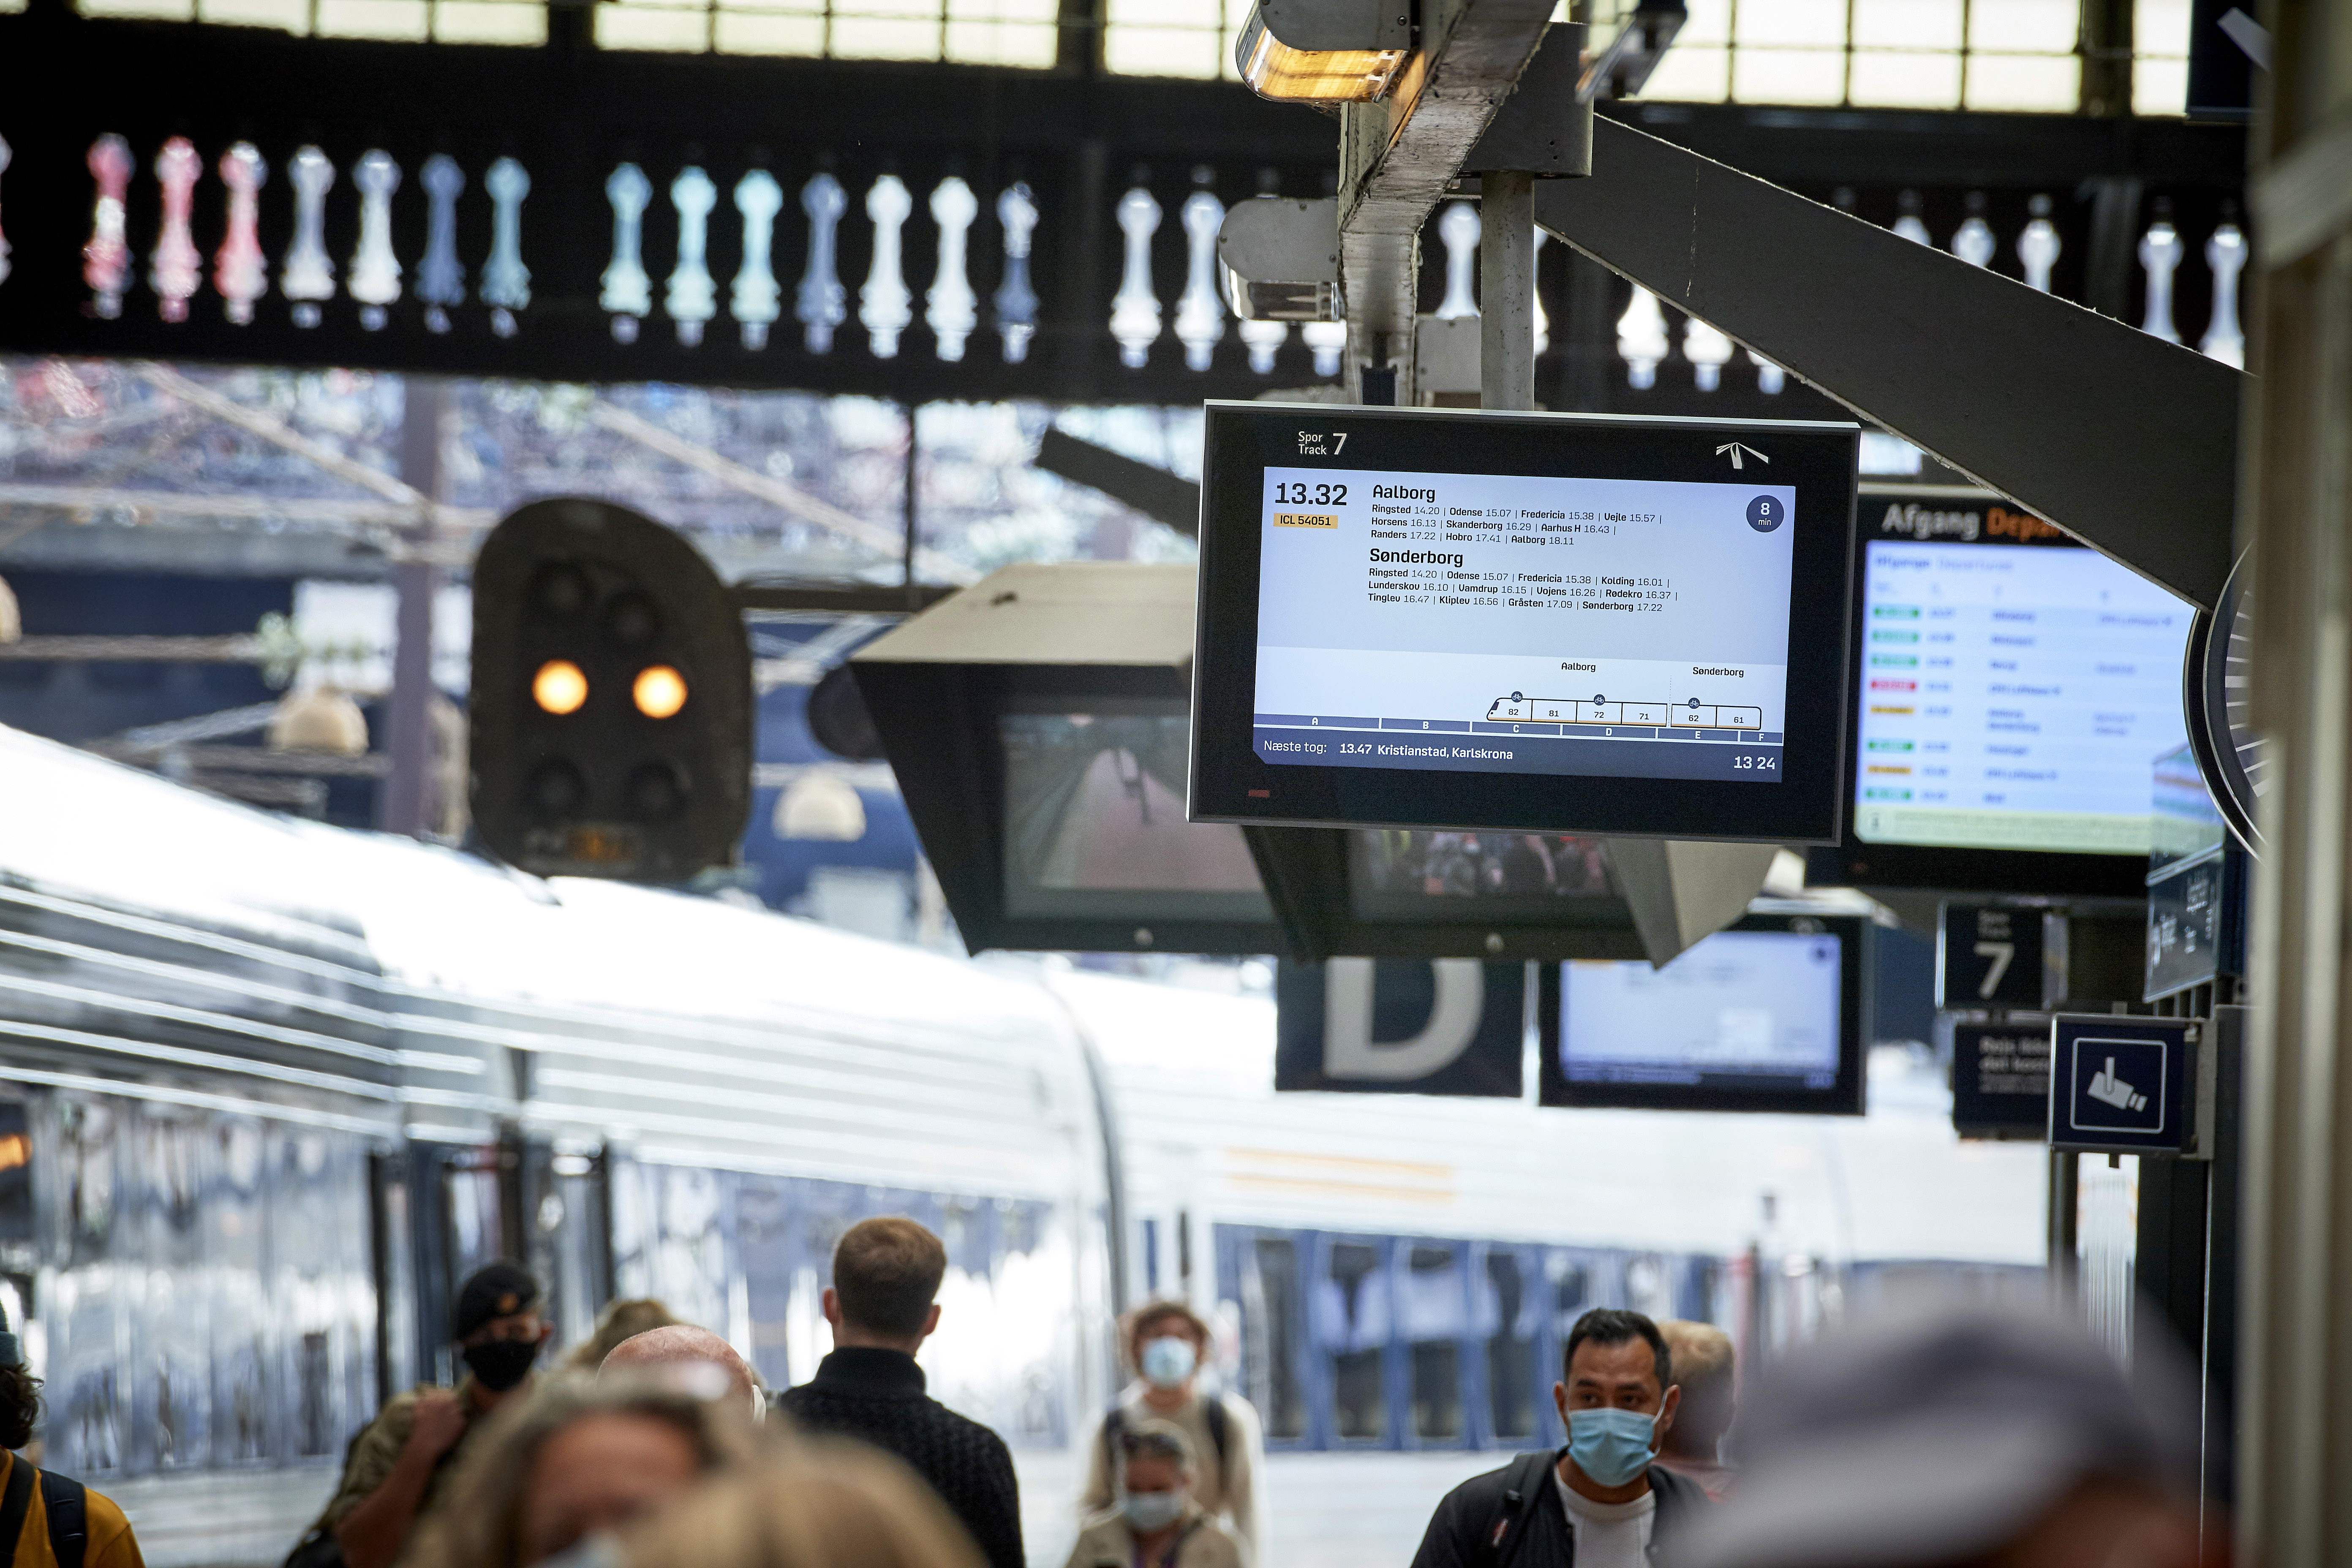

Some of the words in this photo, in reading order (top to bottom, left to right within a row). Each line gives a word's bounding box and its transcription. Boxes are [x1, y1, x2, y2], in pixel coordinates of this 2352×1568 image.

[1298, 431, 1323, 444] Spor
[1333, 433, 1347, 455] 7
[1298, 444, 1326, 455] Track
[1275, 483, 1347, 505] 13.32
[1373, 485, 1435, 503] Aalborg
[1372, 504, 1410, 514] Ringsted
[1450, 508, 1482, 516] Odense
[1522, 510, 1565, 519] Fredericia
[1605, 513, 1626, 522] Vejle
[1761, 503, 1769, 515] 8
[1281, 515, 1295, 524] ICL
[1298, 516, 1331, 525] 54051
[1372, 517, 1407, 525] Horsens
[1447, 520, 1502, 531] Skanderborg
[1506, 523, 1531, 531] 16.29
[1541, 524, 1572, 532] Aarhus
[1883, 504, 1980, 540] Afgang
[1372, 530, 1407, 538] Randers
[1446, 533, 1472, 541] Hobro
[1512, 535, 1545, 545] Aalborg
[1370, 549, 1463, 567] Sønderborg
[1369, 568, 1408, 578] Ringsted
[1448, 572, 1479, 580] Odense
[1519, 574, 1562, 582] Fredericia
[1602, 577, 1634, 586] Kolding
[1369, 581, 1419, 590] Lunderskov
[1459, 584, 1497, 594] Vamdrup
[1537, 587, 1566, 596] Vojens
[1606, 590, 1642, 598] Rødekro
[1368, 593, 1400, 603] Tinglev
[1440, 596, 1470, 605] Kliplev
[1509, 598, 1543, 607] Gråsten
[1583, 602, 1633, 612] Sønderborg
[1562, 662, 1595, 672] Aalborg
[1693, 667, 1744, 678] Sønderborg
[1606, 728, 1612, 736] D
[1696, 731, 1701, 739] E
[1264, 740, 1301, 751] Næste
[1304, 743, 1326, 754] tog:
[1340, 743, 1372, 754] 13.47
[1378, 745, 1449, 758] Kristianstad,
[1452, 748, 1513, 759] Karlskrona
[1734, 757, 1752, 768] 13
[1757, 757, 1775, 769] 24
[1974, 942, 2014, 999] 7
